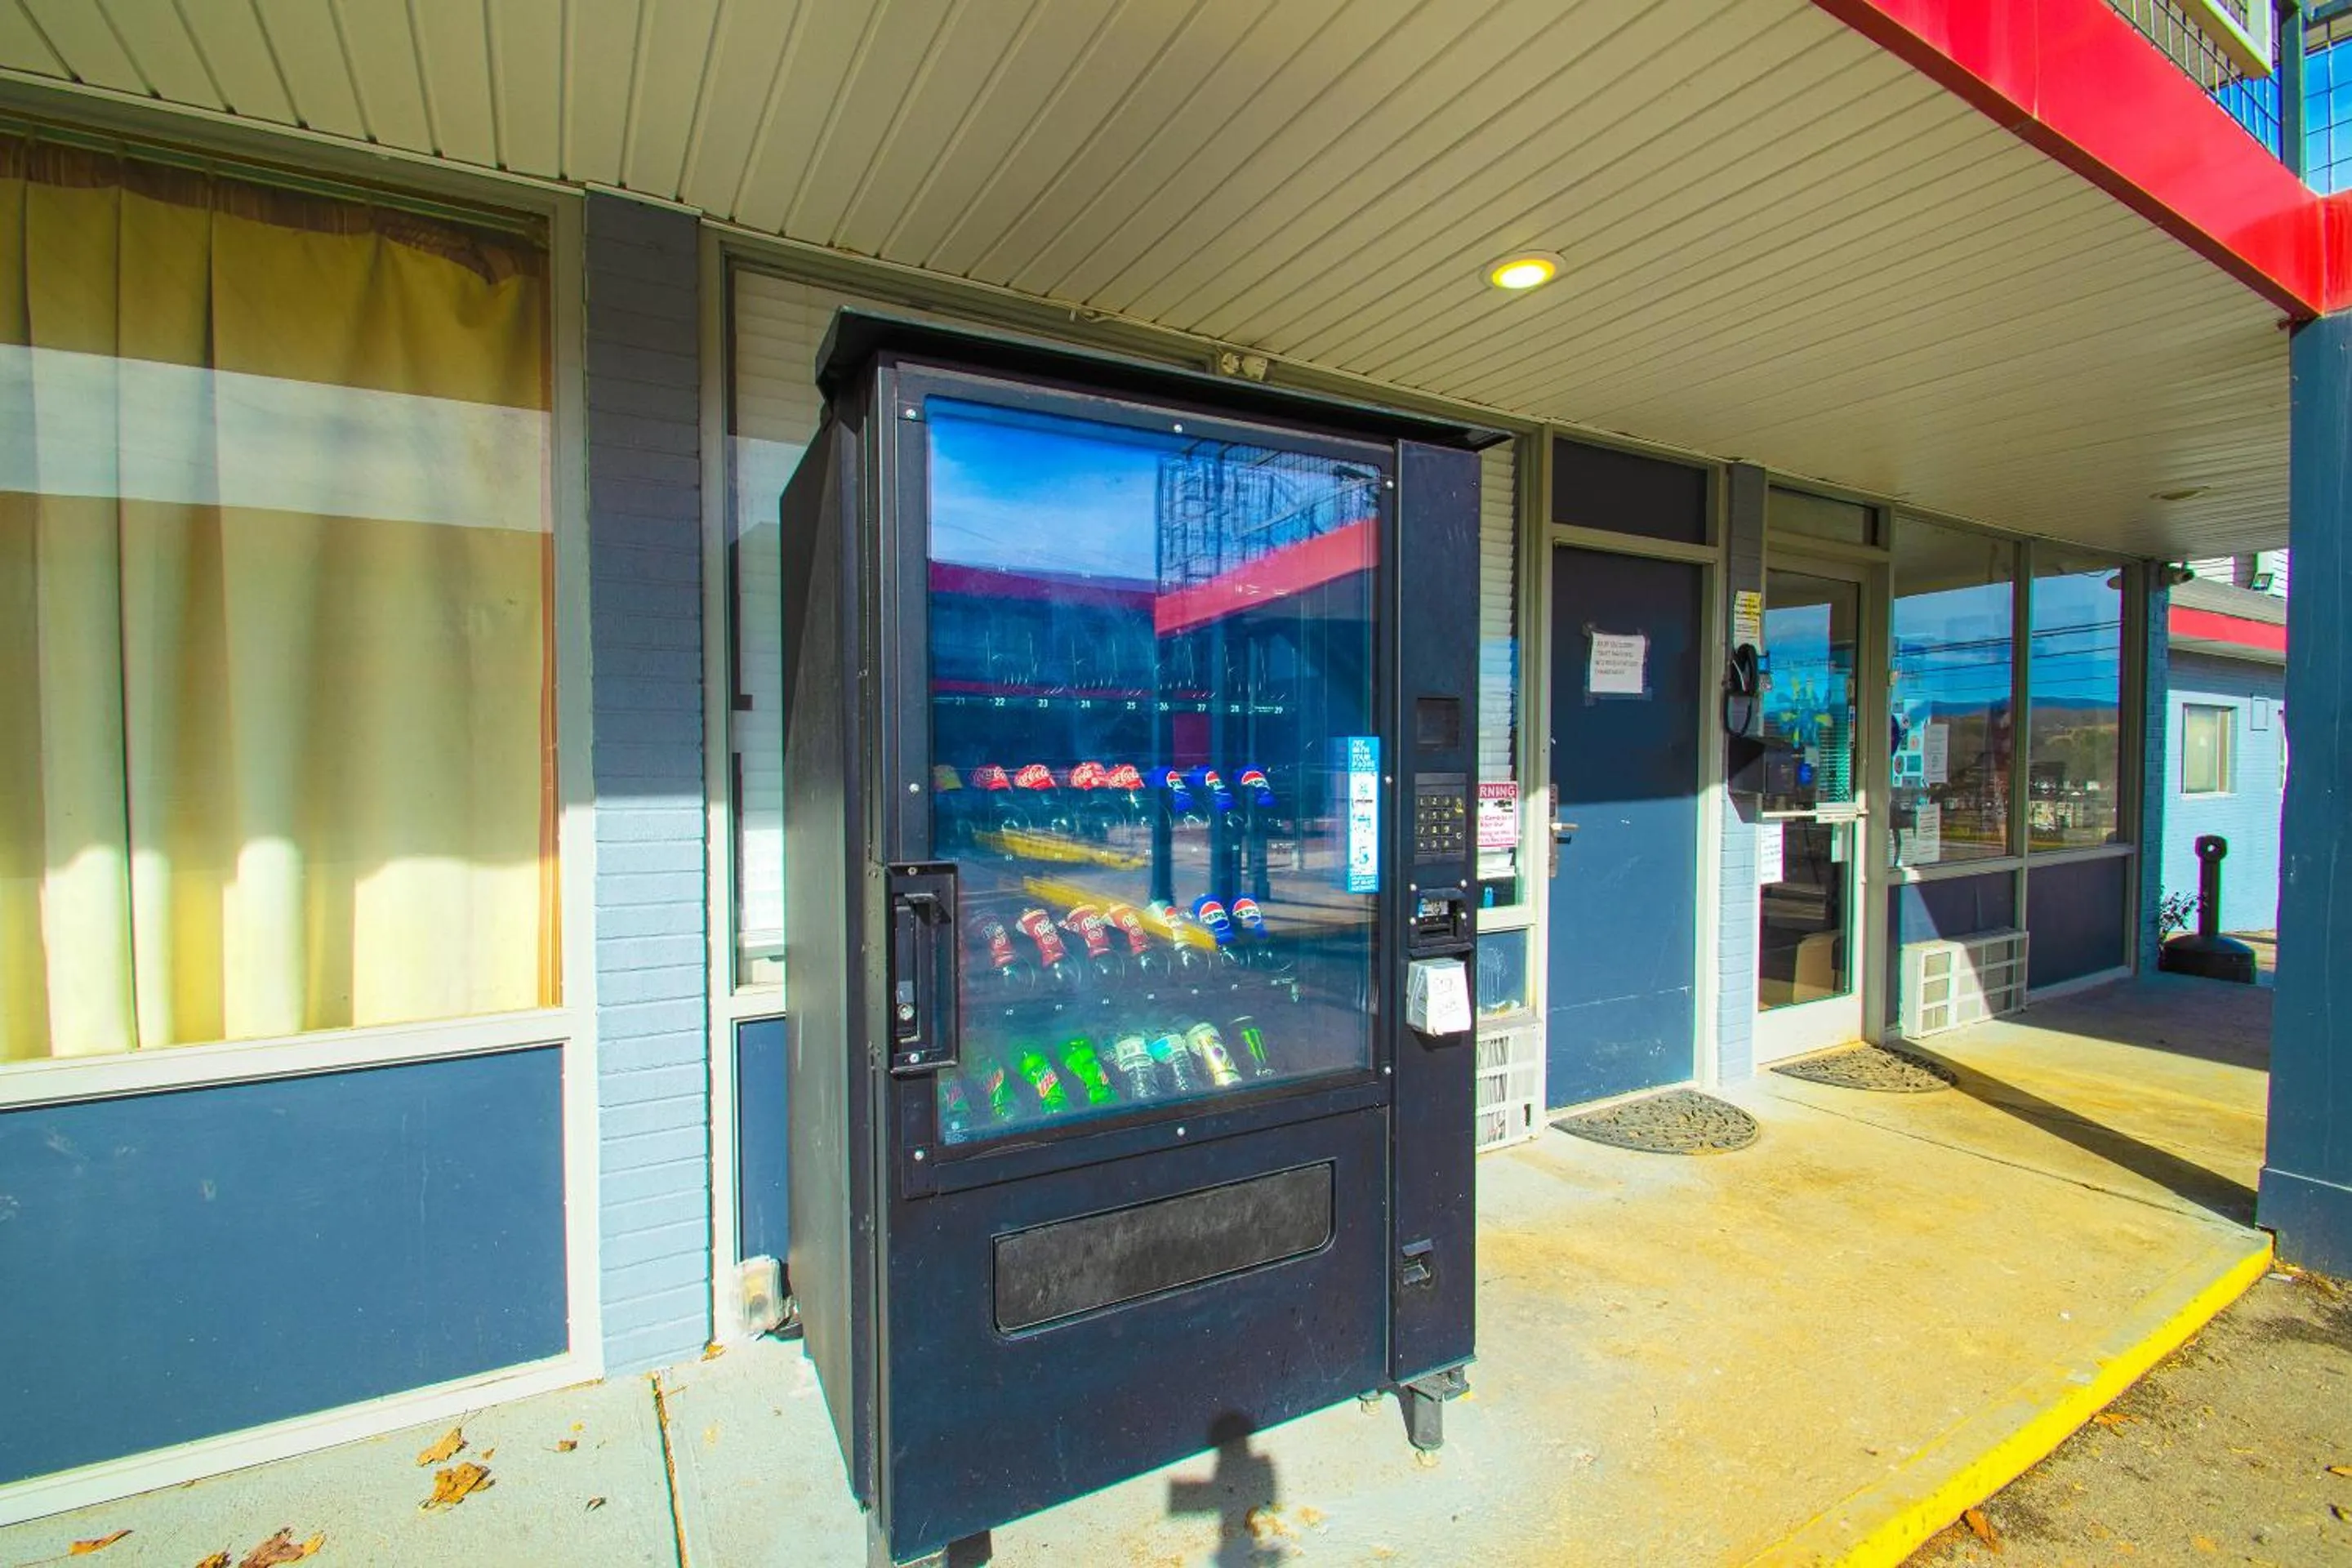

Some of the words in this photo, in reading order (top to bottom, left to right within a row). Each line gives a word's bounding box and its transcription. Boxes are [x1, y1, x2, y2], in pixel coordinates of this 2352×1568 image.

[995, 697, 1006, 706] 22
[1038, 698, 1049, 708] 23
[1126, 702, 1136, 710] 25
[1159, 702, 1169, 711] 26
[1197, 703, 1206, 712] 27
[1274, 706, 1284, 715] 29
[1480, 786, 1517, 798] RNING
[1432, 797, 1437, 805] 2
